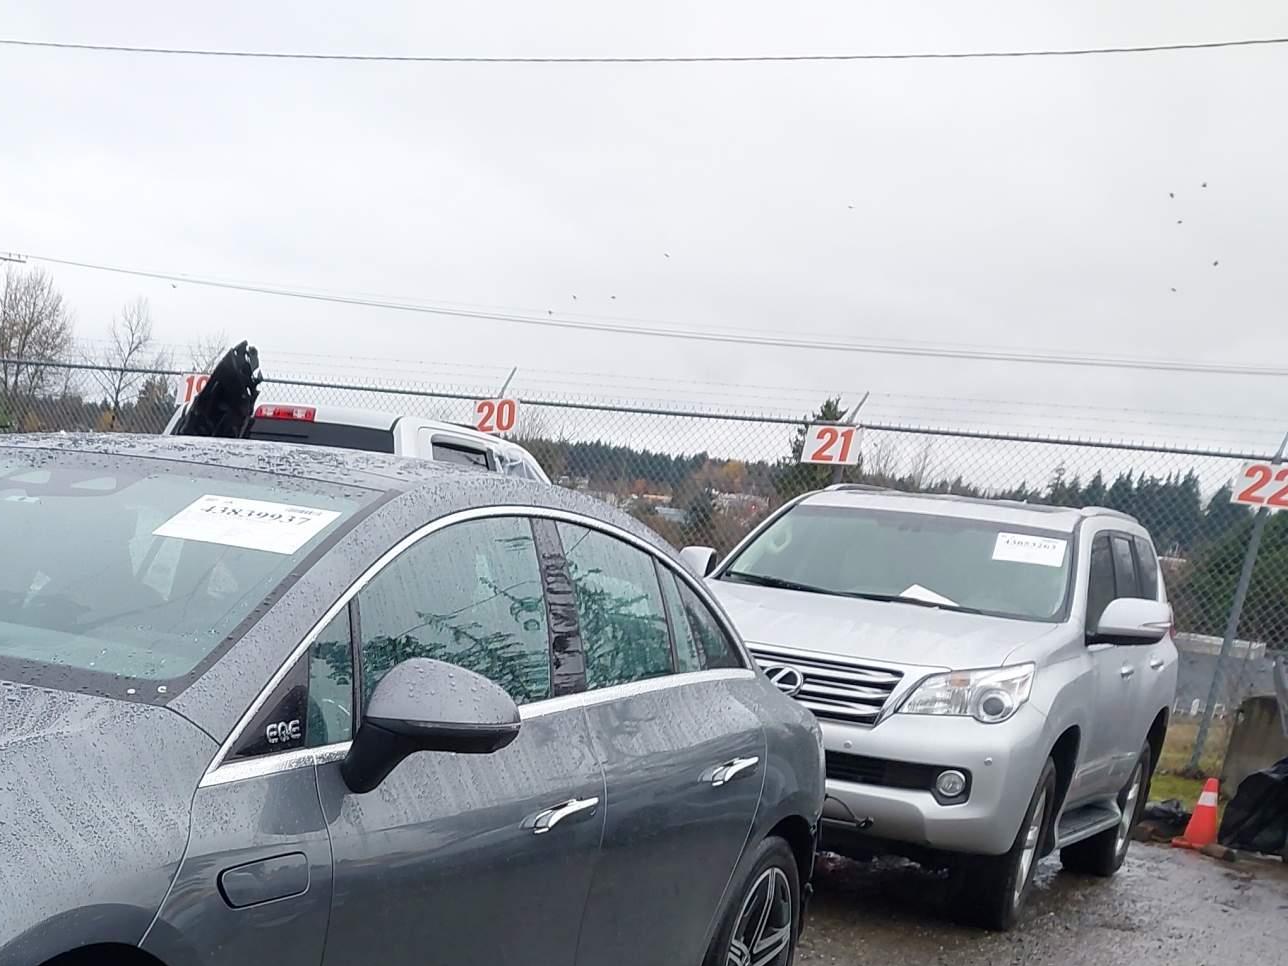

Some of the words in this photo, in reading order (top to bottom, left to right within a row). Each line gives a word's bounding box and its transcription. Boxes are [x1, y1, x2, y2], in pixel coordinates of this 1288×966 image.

[477, 399, 516, 432] 20
[811, 427, 854, 462] 21
[266, 719, 301, 744] EQE
